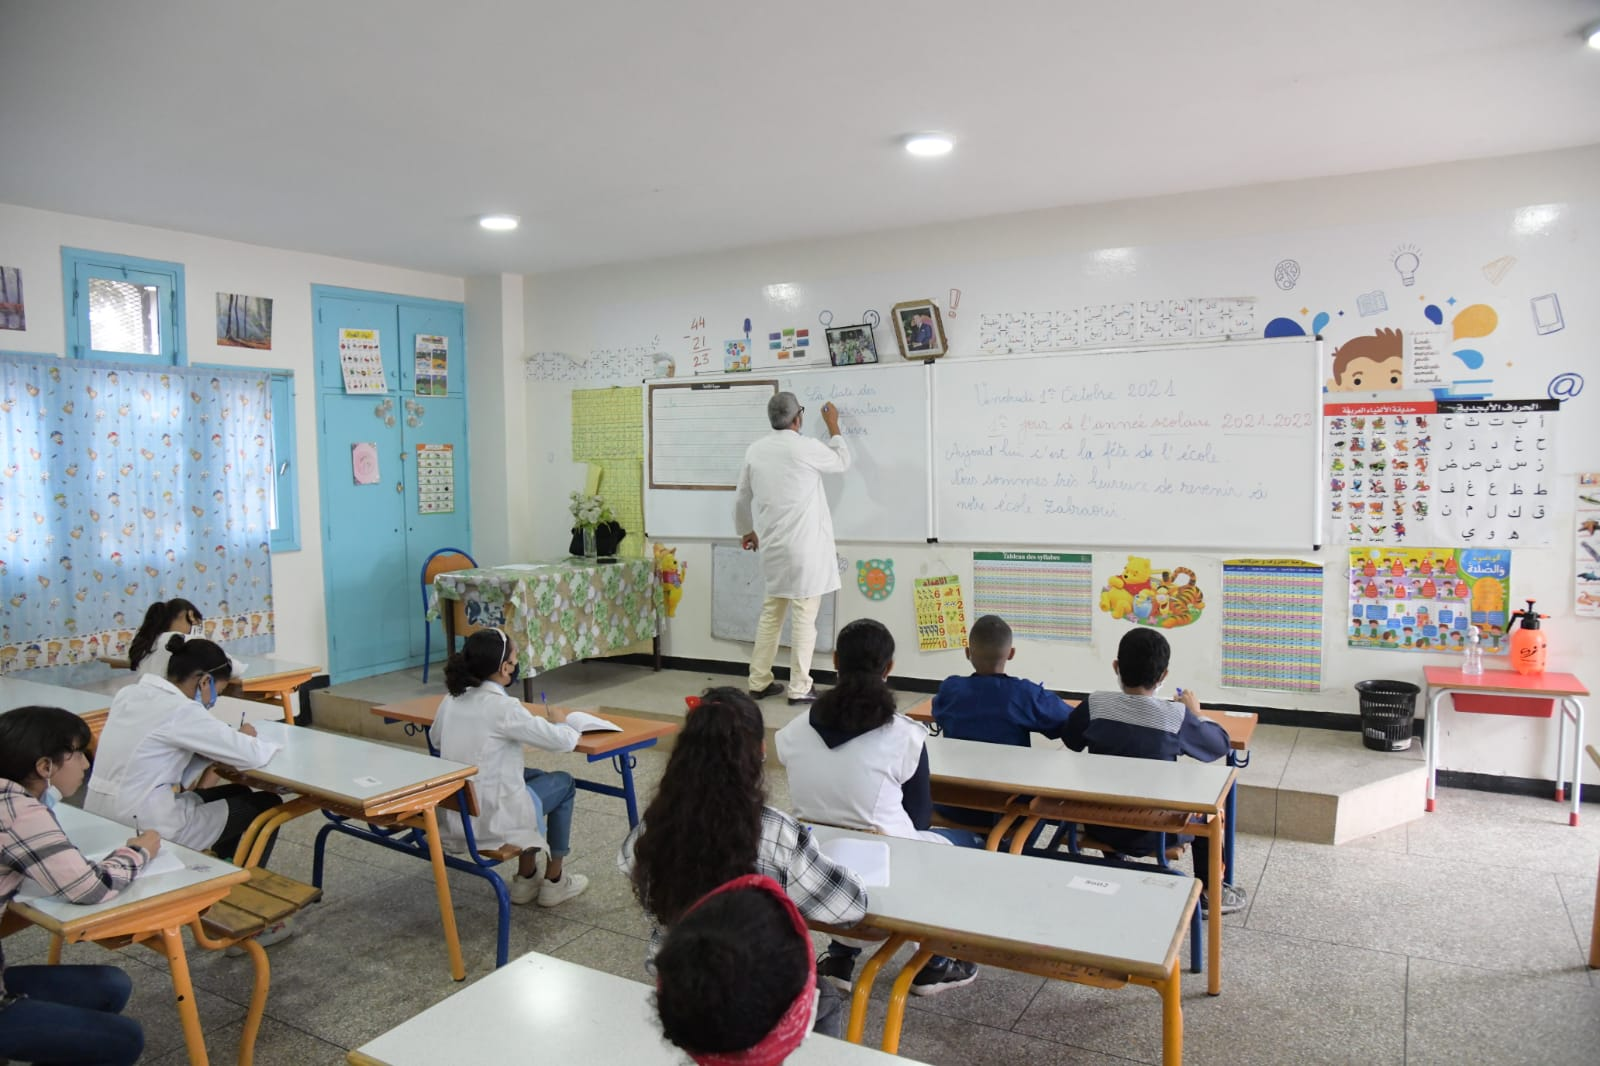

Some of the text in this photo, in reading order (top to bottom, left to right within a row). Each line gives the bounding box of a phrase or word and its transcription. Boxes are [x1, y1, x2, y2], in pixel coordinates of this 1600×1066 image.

[690, 315, 705, 330] 44
[693, 335, 706, 351] 21
[693, 353, 710, 368] 23
[1127, 379, 1176, 399] 2021
[1444, 414, 1544, 430] أ ب ت ث ج
[1078, 438, 1096, 460] la
[1135, 442, 1154, 459] de
[1445, 435, 1547, 452] ح خ د ذ ر
[1438, 458, 1544, 472] ز س ش ص ض
[981, 474, 1049, 488] sommes
[1439, 482, 1455, 494] ف
[1466, 480, 1476, 497] غ
[1488, 482, 1498, 496] ع
[1509, 483, 1524, 495] ظ
[1533, 483, 1548, 496] ط
[1441, 504, 1545, 519] ق ك ل م ن
[1461, 528, 1476, 541] ي
[1002, 551, 1061, 562] Tableau des syllabes
[934, 588, 961, 599] 6 1
[936, 600, 963, 611] 7 2
[938, 613, 964, 624] 8 3
[939, 625, 966, 636] 9 4
[938, 638, 968, 649] 10 5
